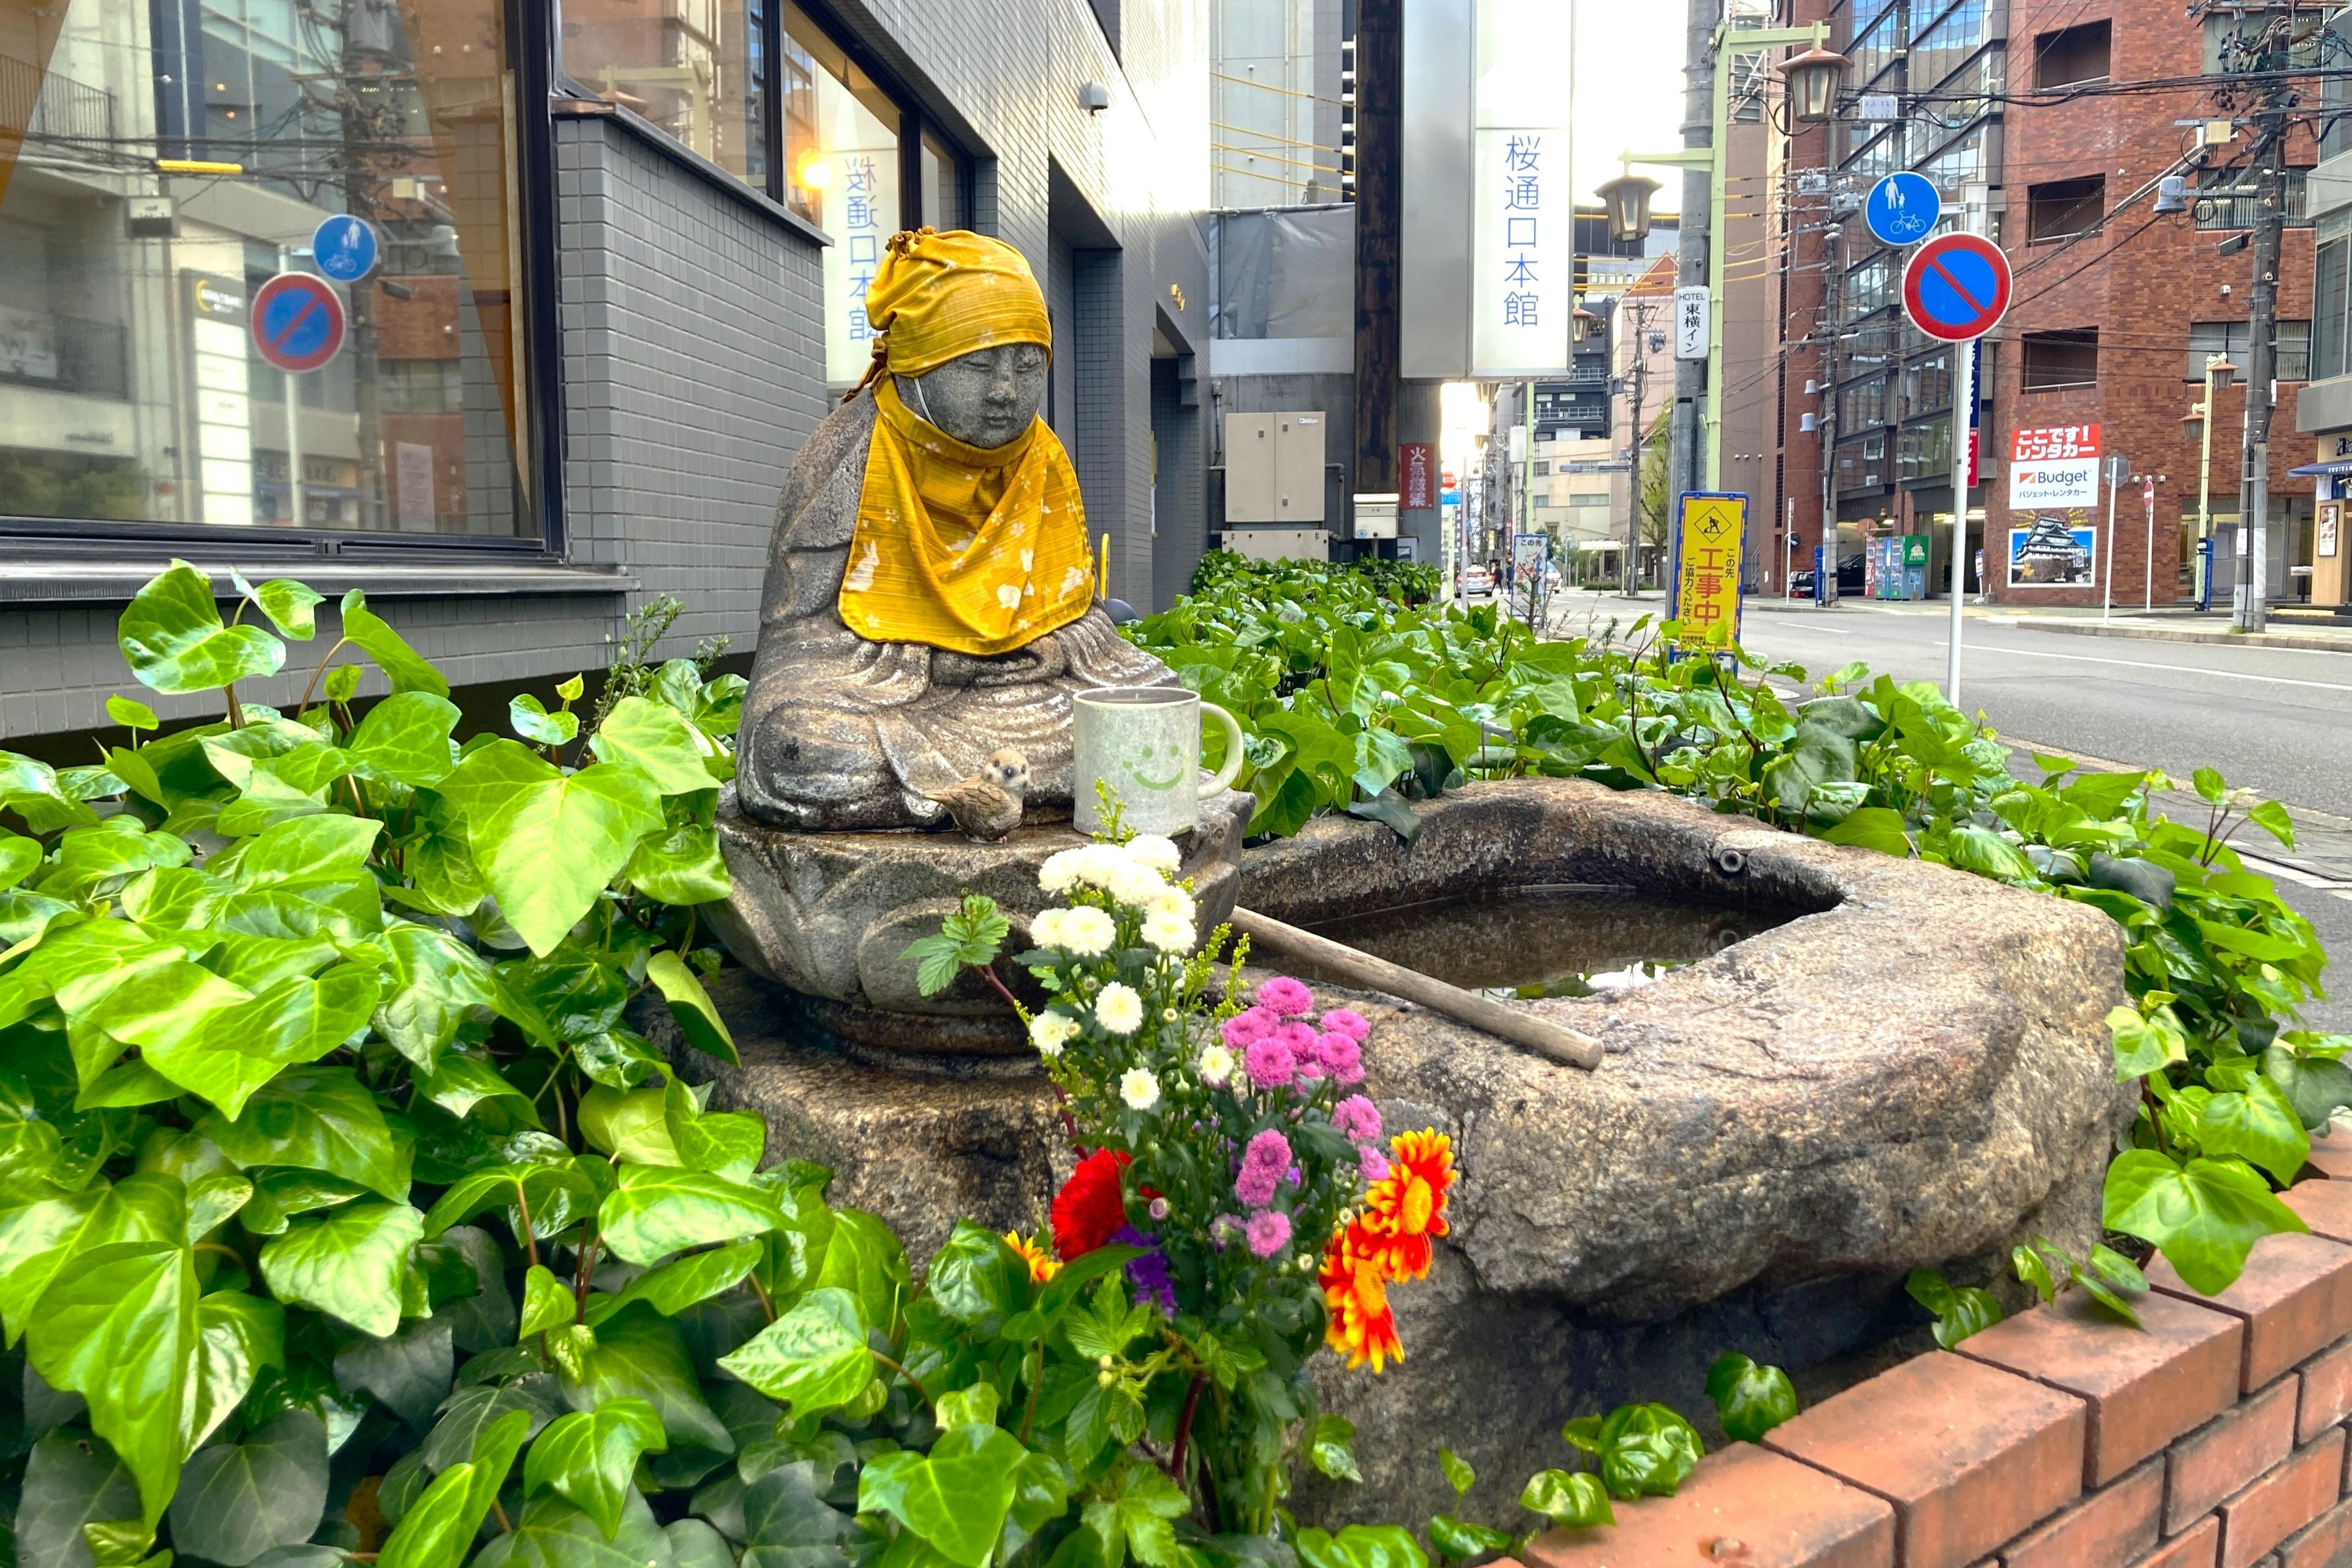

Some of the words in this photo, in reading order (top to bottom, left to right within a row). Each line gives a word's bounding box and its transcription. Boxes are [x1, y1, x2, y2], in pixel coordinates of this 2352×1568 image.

[1504, 135, 1541, 326] 桜通口本館
[1684, 303, 1701, 353] 東横イン
[2018, 425, 2089, 445] ここです！
[2016, 442, 2095, 460] レンタカー
[2038, 470, 2088, 486] Budget
[2019, 489, 2087, 498] バジェット・レンタカー
[1725, 549, 1735, 578] この先
[1683, 556, 1696, 626] ご協力ください
[1694, 548, 1724, 627] 工事中
